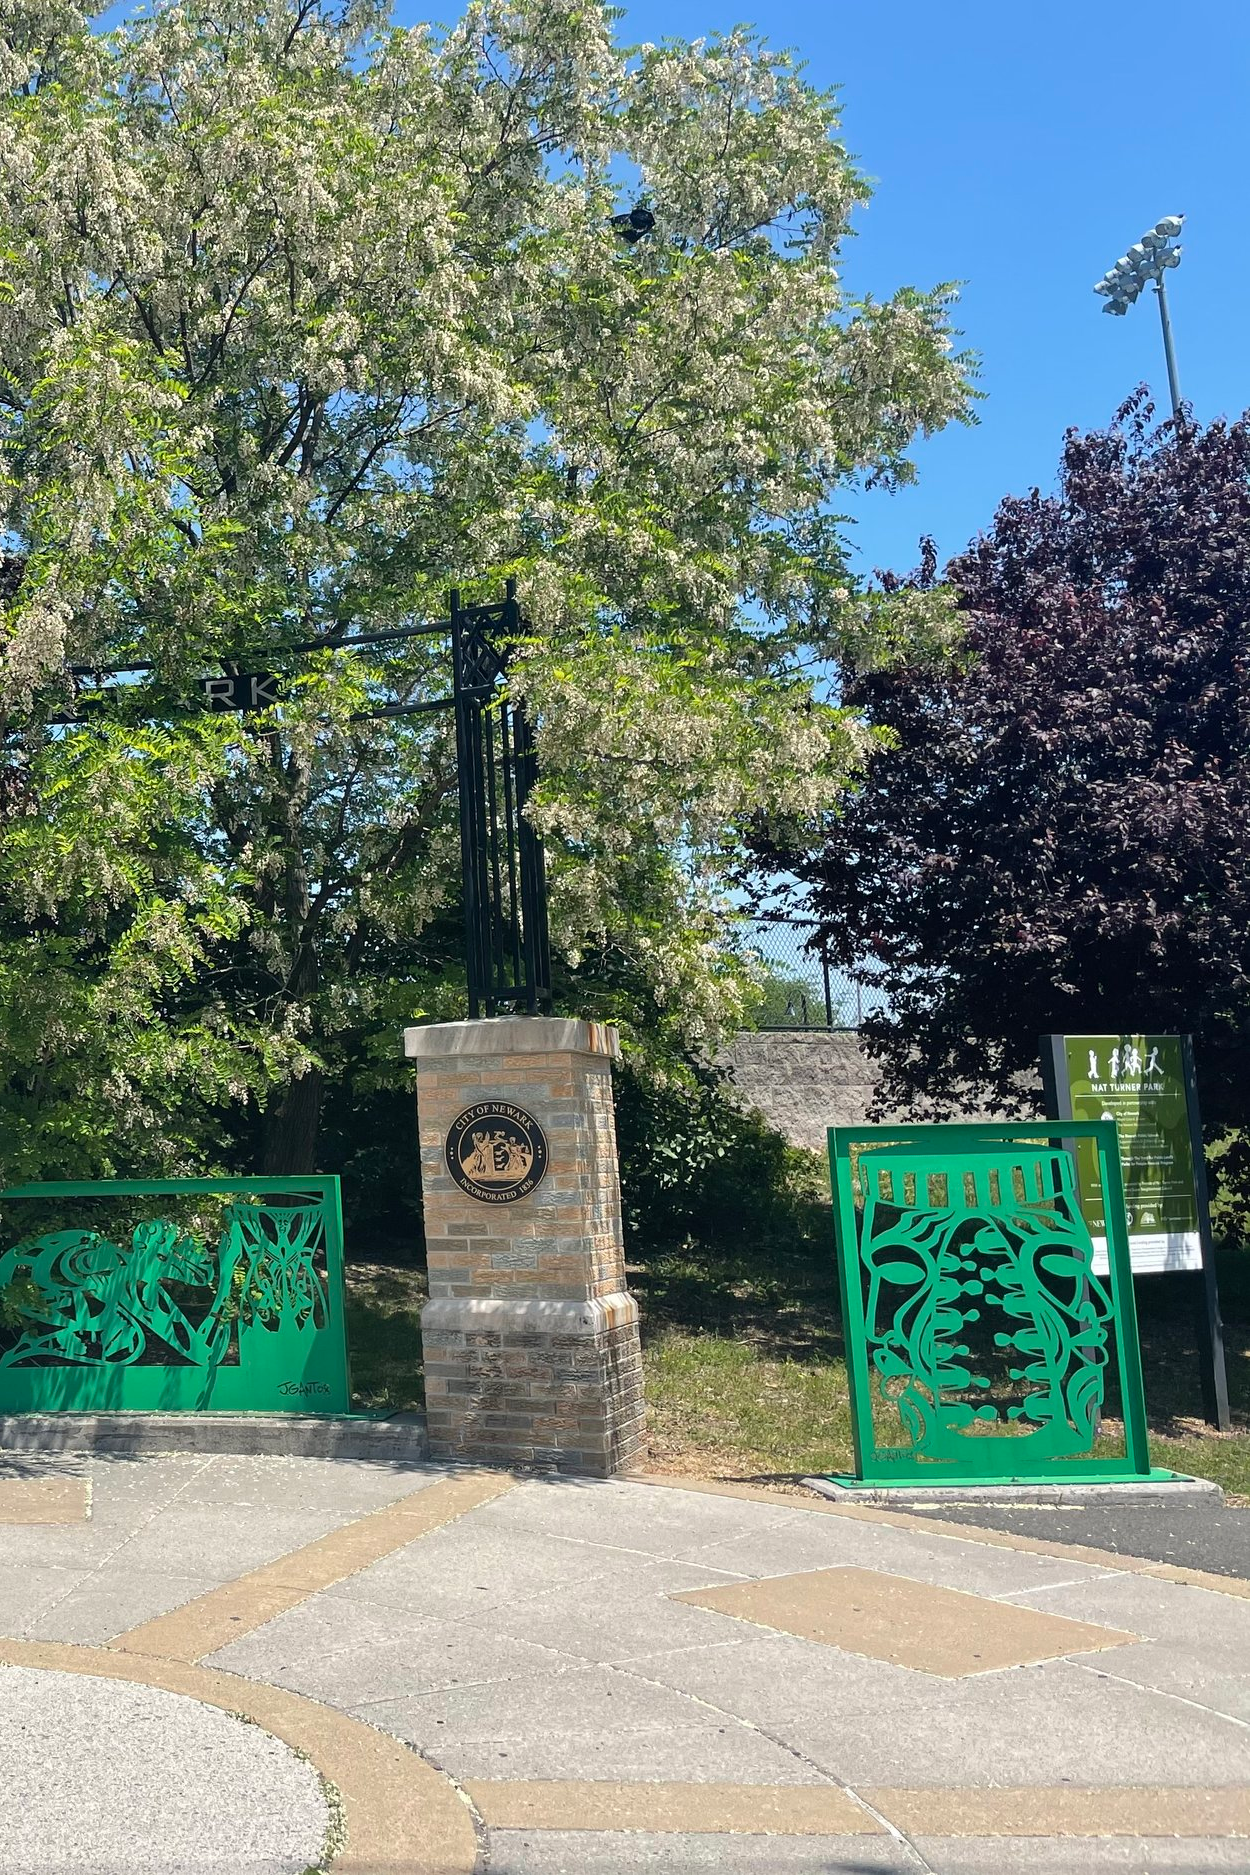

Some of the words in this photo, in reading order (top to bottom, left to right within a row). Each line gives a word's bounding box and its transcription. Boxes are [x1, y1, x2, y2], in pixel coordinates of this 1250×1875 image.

[1091, 1083, 1108, 1092] NAT
[1109, 1083, 1141, 1092] TURNER
[1143, 1082, 1164, 1091] PARK
[455, 1109, 474, 1130] CITY
[476, 1104, 490, 1115] OF
[492, 1104, 534, 1130] NEWARK
[460, 1177, 518, 1201] INCORPORATED
[518, 1178, 534, 1194] 1836
